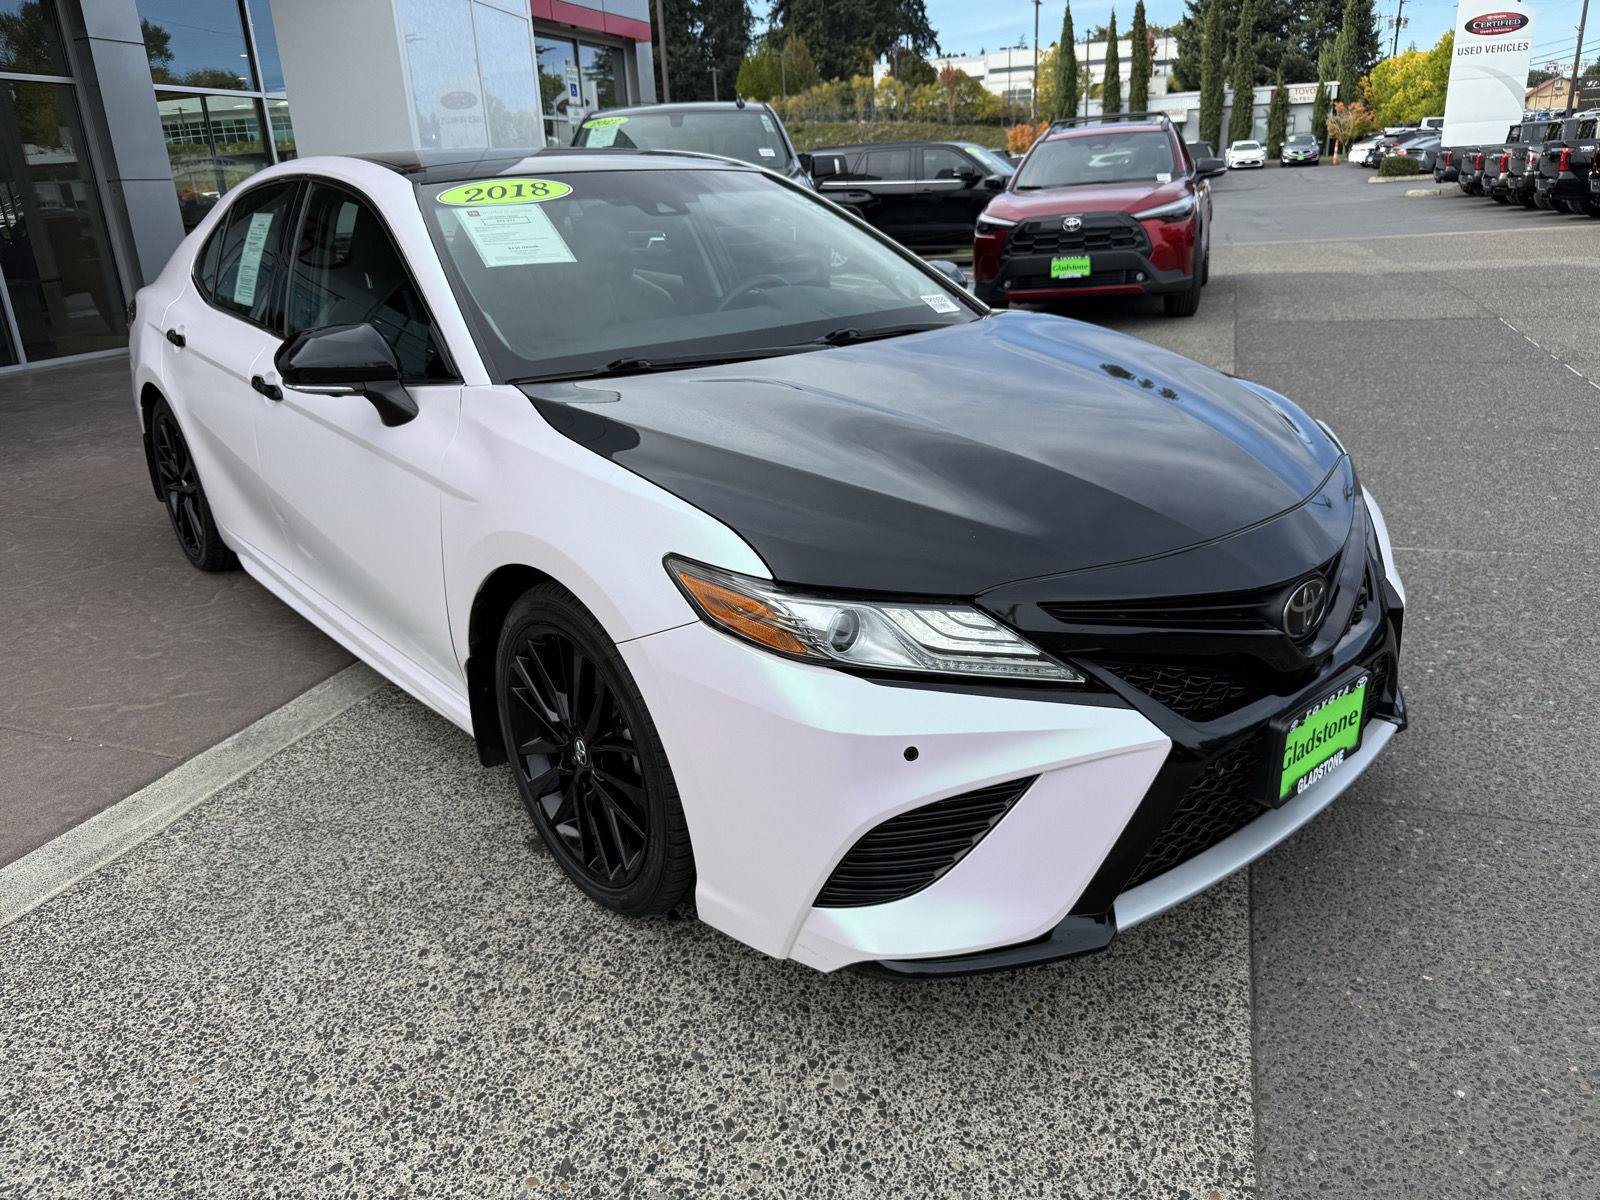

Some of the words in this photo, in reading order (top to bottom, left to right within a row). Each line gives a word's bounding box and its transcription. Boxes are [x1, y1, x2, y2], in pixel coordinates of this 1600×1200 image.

[1472, 18, 1521, 29] CERTIFIED
[1457, 46, 1482, 56] USED
[1485, 42, 1529, 54] VEHICLES
[464, 182, 550, 203] 2018
[1282, 709, 1358, 771] Gladstone
[1297, 748, 1345, 794] GLADSTONE
